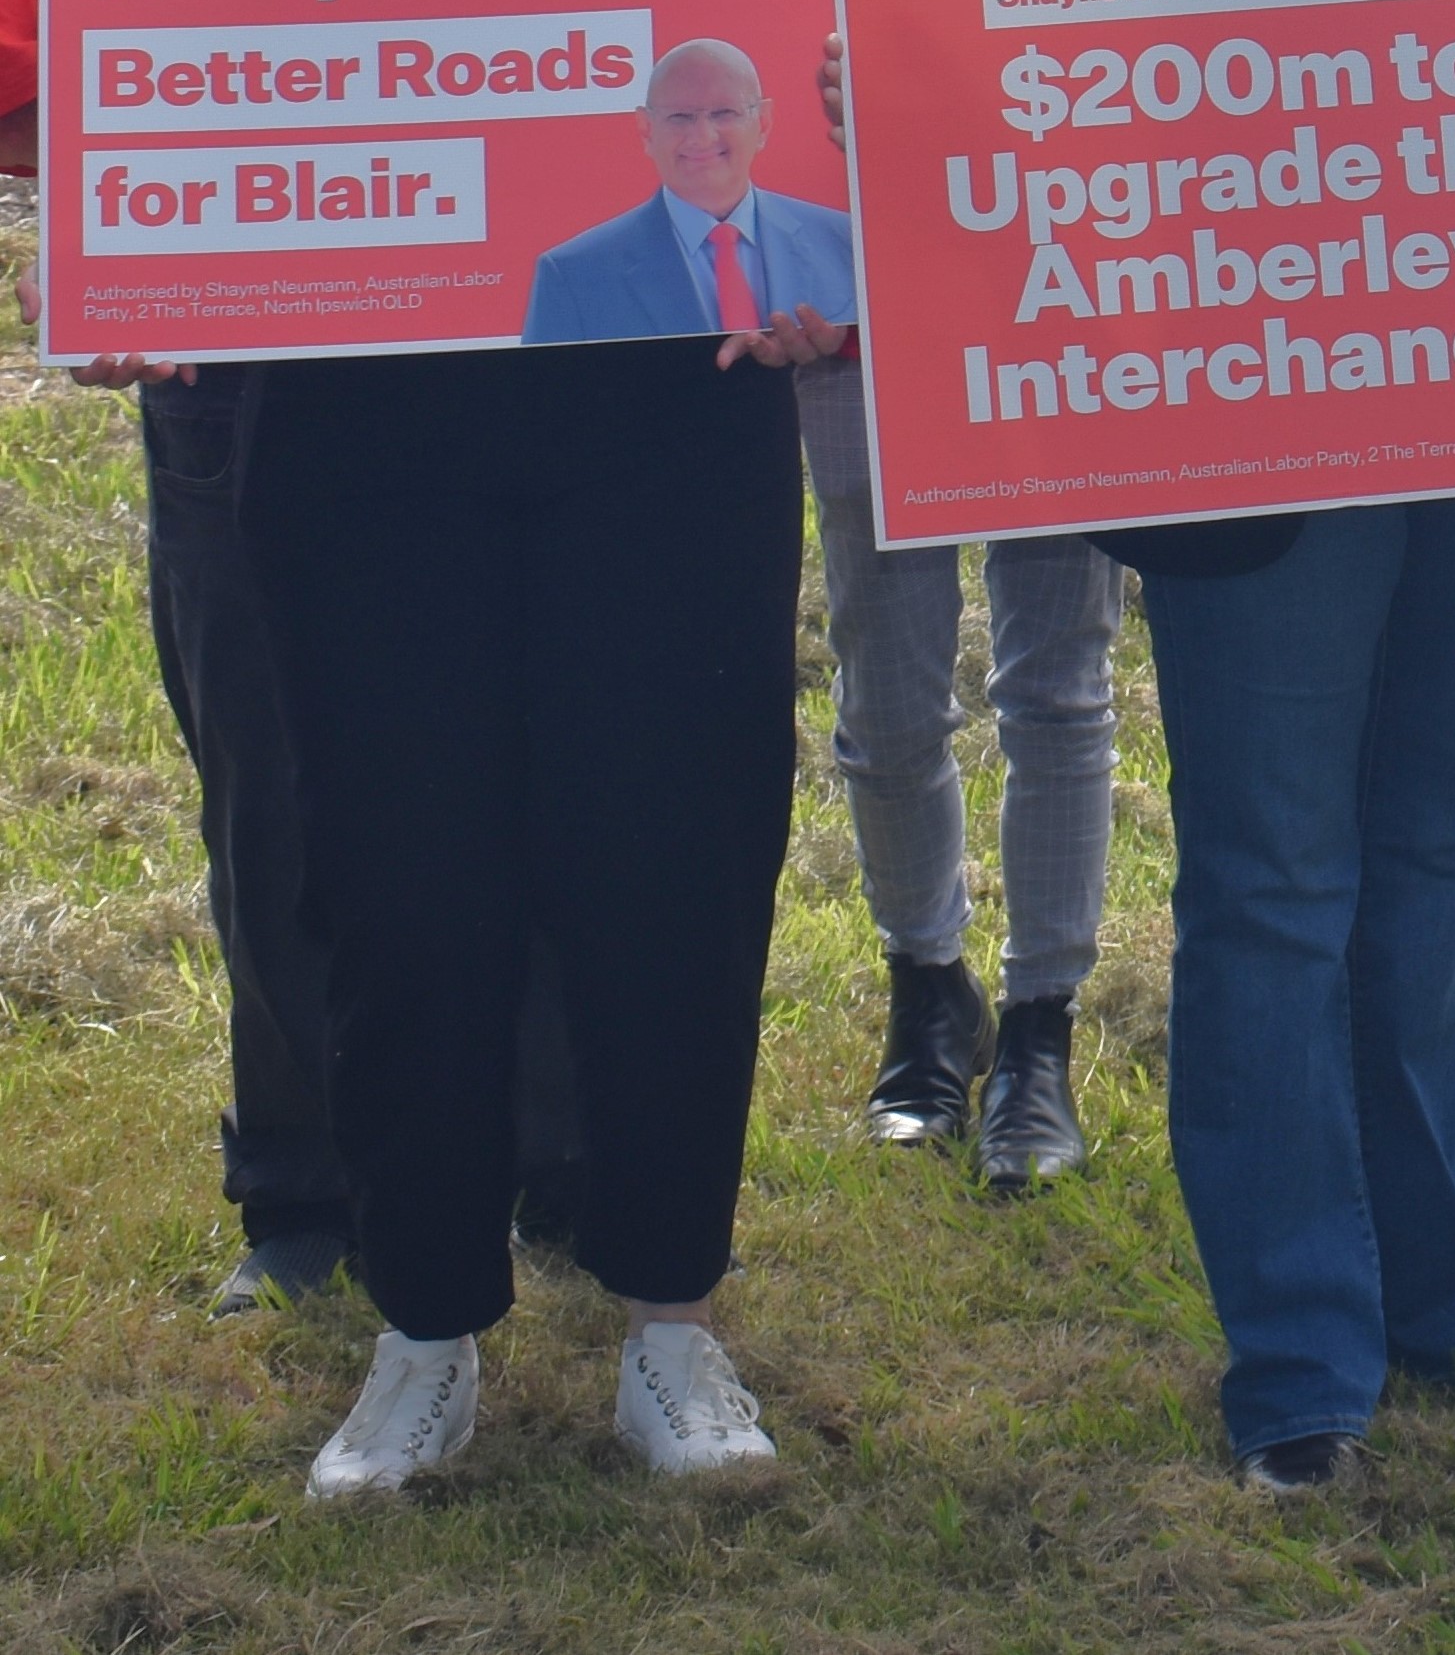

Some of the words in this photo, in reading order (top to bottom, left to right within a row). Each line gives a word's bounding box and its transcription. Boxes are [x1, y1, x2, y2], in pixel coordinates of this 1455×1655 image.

[100, 49, 360, 107] Better
[379, 30, 635, 98] Roads
[1001, 37, 1374, 142] $200m
[96, 166, 217, 227] for
[236, 158, 456, 223] Blair.
[944, 124, 1382, 246] Upgrade
[84, 283, 178, 301] Authorised
[181, 283, 201, 300] by
[205, 281, 270, 301] Shayne
[272, 279, 362, 296] Neumann,
[365, 273, 450, 291] Australian
[453, 271, 504, 287] Labor
[84, 305, 135, 323] Party,
[136, 304, 149, 320] 2
[152, 303, 186, 319] The
[189, 302, 260, 318] Terrace,
[264, 298, 312, 315] North
[316, 297, 380, 315] Ipswich
[382, 293, 423, 310] QLD
[904, 482, 996, 505] Authorised
[999, 480, 1020, 498] by
[1023, 476, 1086, 494] Shayne
[1088, 467, 1175, 487] Neumann,
[1179, 459, 1262, 479] Australian
[1265, 454, 1314, 472] Labor
[1316, 450, 1366, 467] Party,
[1367, 446, 1379, 462] 2
[1380, 444, 1415, 460] The
